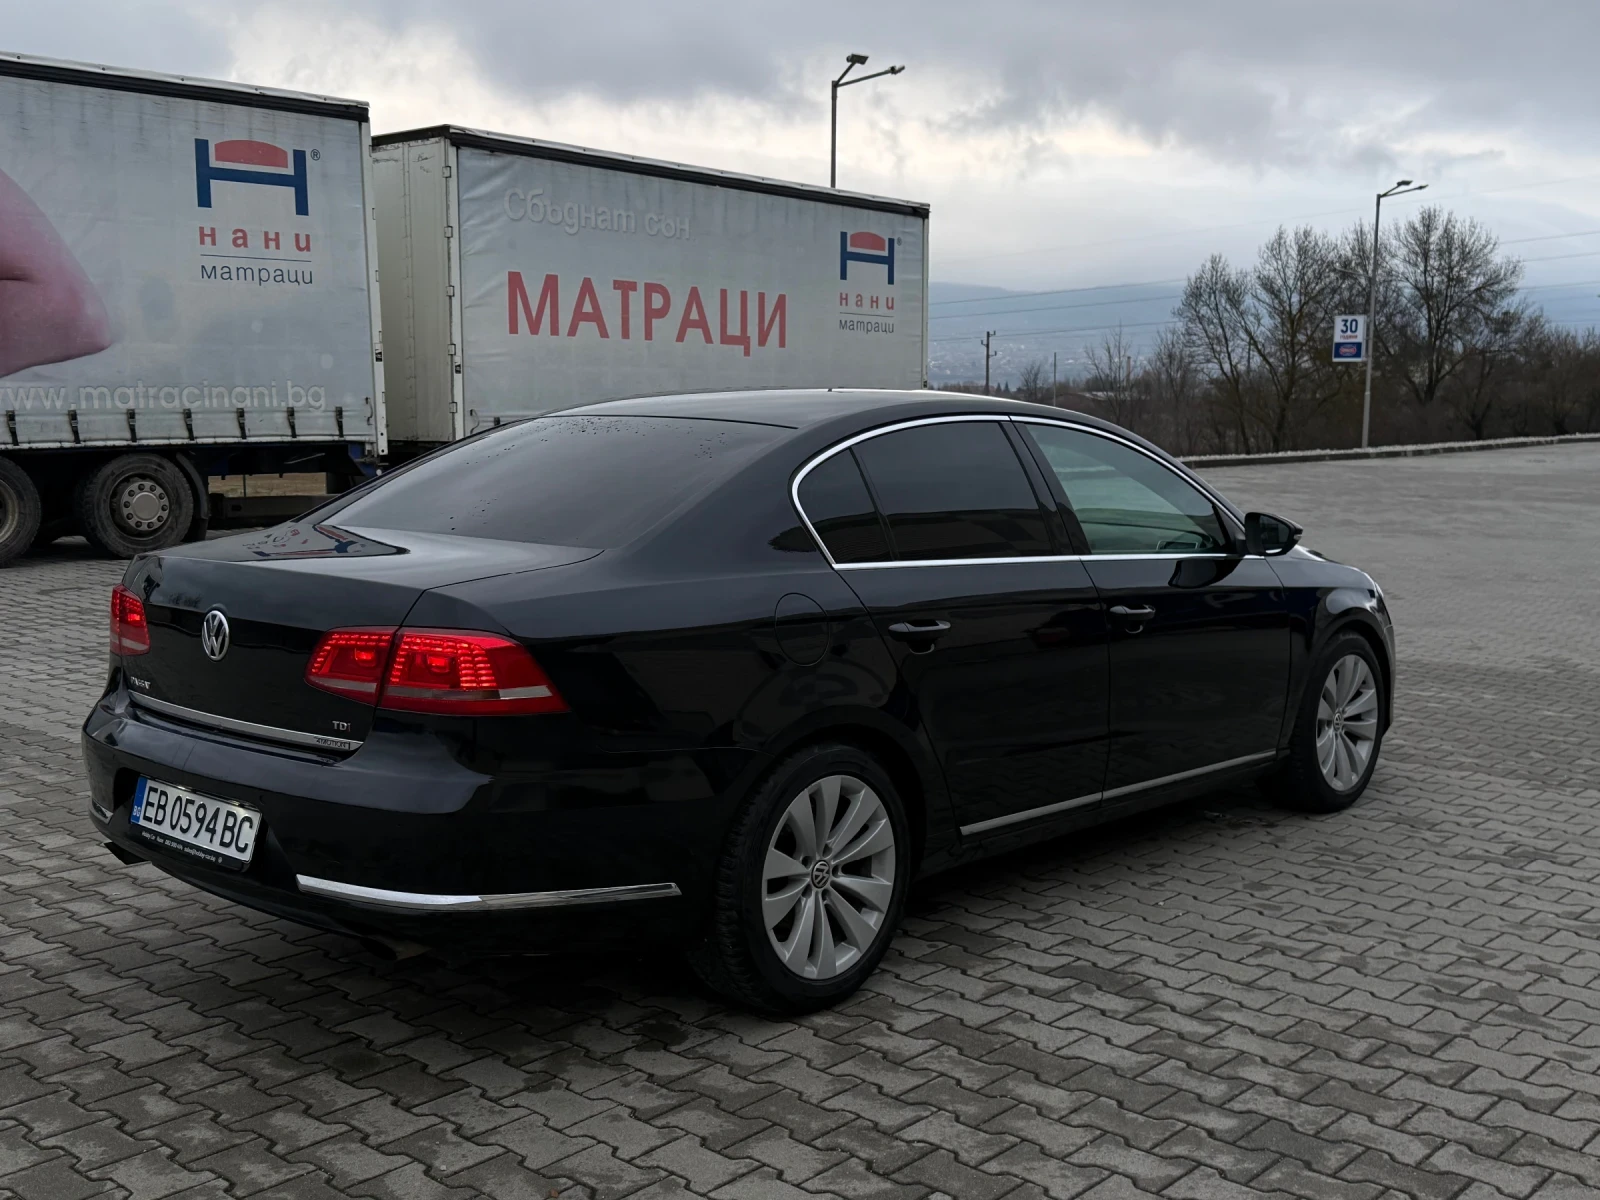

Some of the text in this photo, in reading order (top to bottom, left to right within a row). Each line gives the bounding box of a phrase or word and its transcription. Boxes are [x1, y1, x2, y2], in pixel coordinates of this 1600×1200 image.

[503, 187, 692, 241] Сбъднат сон
[199, 226, 311, 252] нани
[201, 264, 313, 286] матраци
[507, 270, 788, 358] МАТРАЦИ
[839, 319, 895, 335] матраци
[1340, 318, 1359, 334] 30
[0, 379, 327, 413] ww.matracinani.bg
[143, 786, 169, 826] EB
[170, 795, 220, 844] 0594
[219, 810, 254, 853] BC
